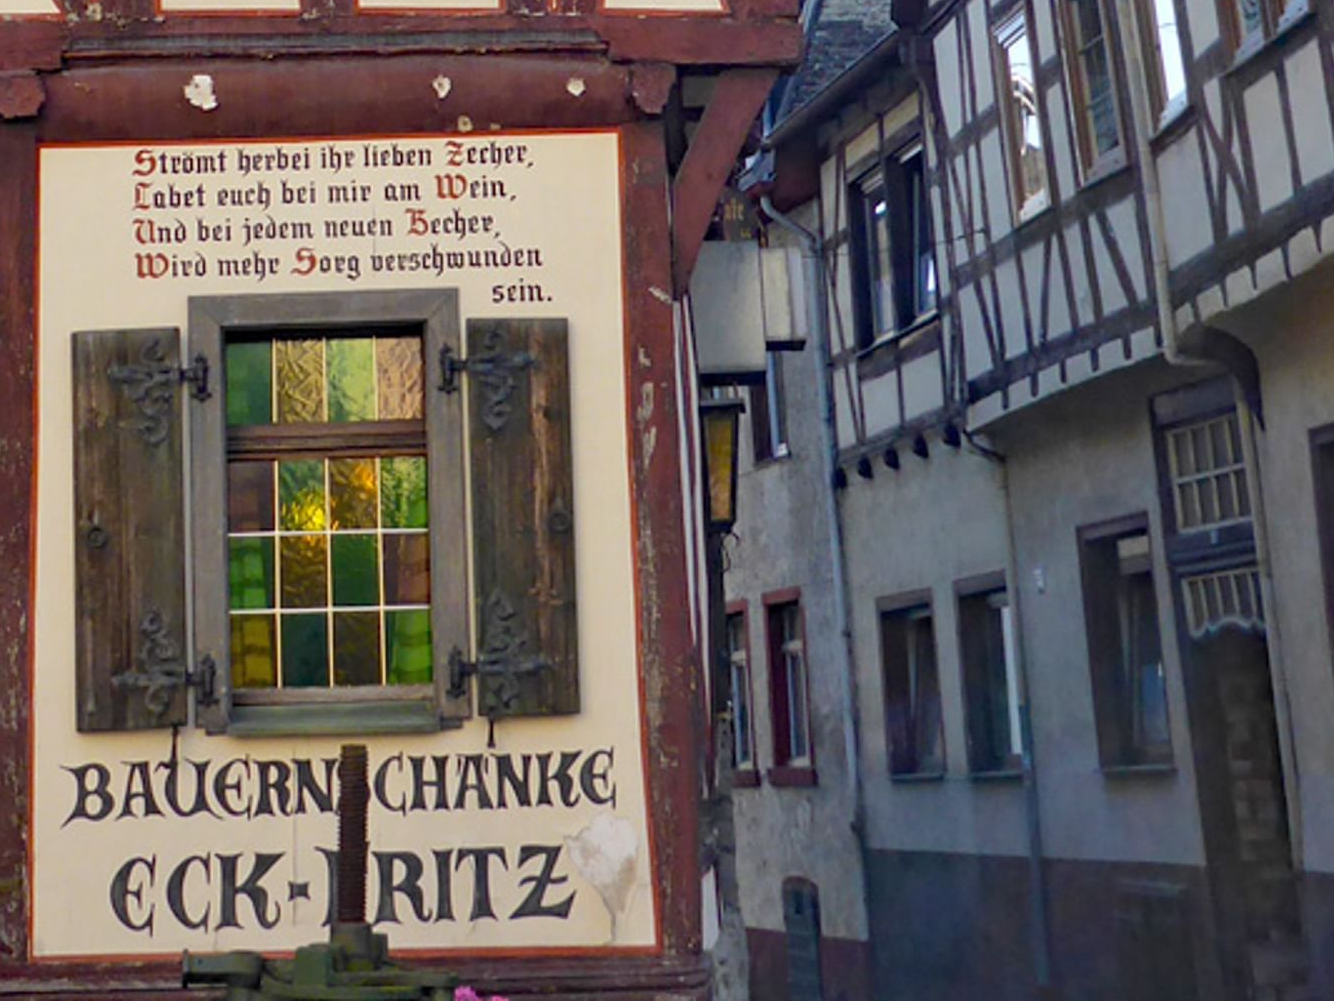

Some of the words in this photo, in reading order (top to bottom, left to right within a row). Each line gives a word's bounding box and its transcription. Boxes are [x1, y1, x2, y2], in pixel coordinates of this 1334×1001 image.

[132, 149, 227, 177] Strömt
[235, 147, 311, 176] herbei
[321, 145, 356, 173] ihr
[362, 143, 432, 168] lieben
[445, 140, 534, 169] Zecher,
[132, 181, 206, 211] Labet
[217, 180, 272, 211] euch
[281, 179, 317, 205] bei
[327, 180, 372, 204] mir
[384, 182, 421, 202] am
[434, 173, 517, 202] Wein,
[132, 216, 187, 245] Und
[196, 216, 232, 243] bei
[241, 214, 314, 246] jedem
[324, 216, 393, 239] neuen
[404, 207, 501, 240] Becher,
[135, 250, 208, 280] Wird
[217, 249, 281, 282] mehr
[290, 246, 362, 281] Sorg
[370, 240, 544, 277] verschwunden
[491, 277, 554, 304] sein.
[60, 746, 617, 827] BAUERNCHÄNKE
